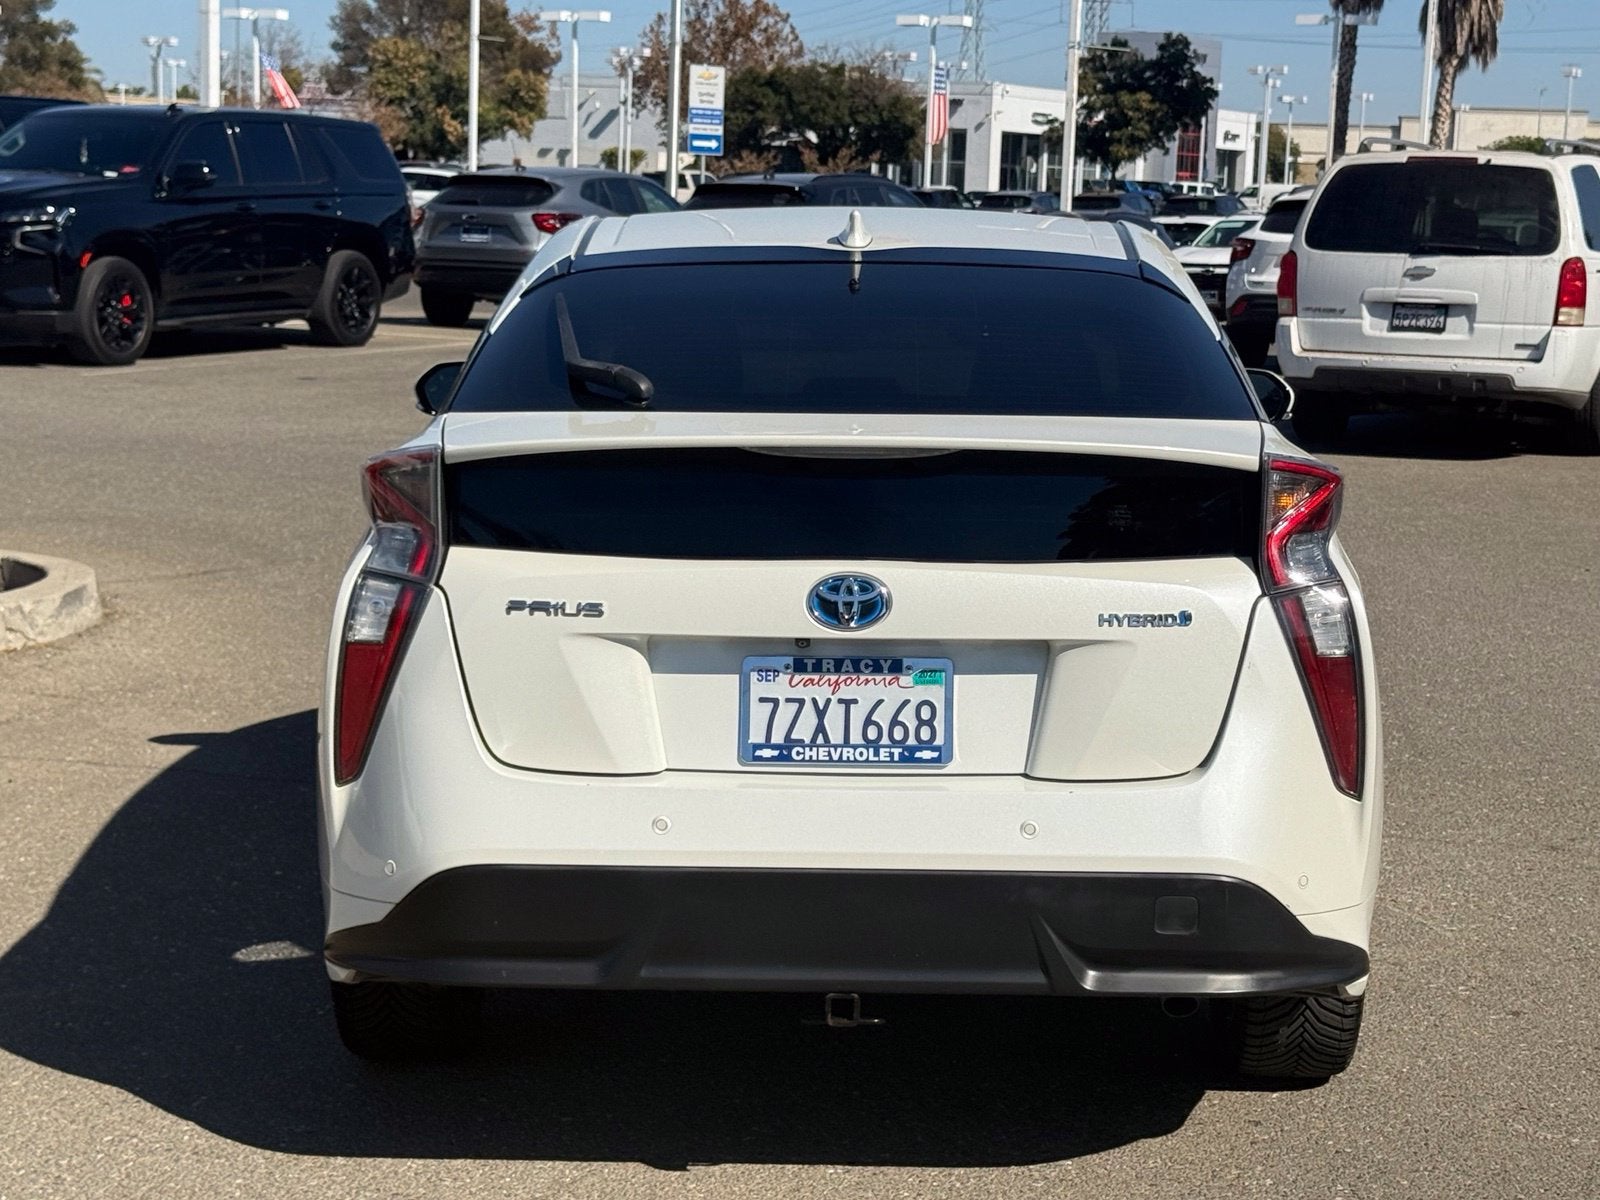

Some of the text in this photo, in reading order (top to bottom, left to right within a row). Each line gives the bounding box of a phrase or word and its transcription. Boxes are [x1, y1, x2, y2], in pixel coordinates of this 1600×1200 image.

[505, 600, 604, 618] PRIUS
[1098, 613, 1178, 628] HYBRID
[804, 658, 893, 674] TRACY
[756, 668, 780, 683] SEP
[788, 673, 916, 696] California
[758, 696, 938, 746] 7ZXT668
[791, 747, 903, 762] CHEVROLET
